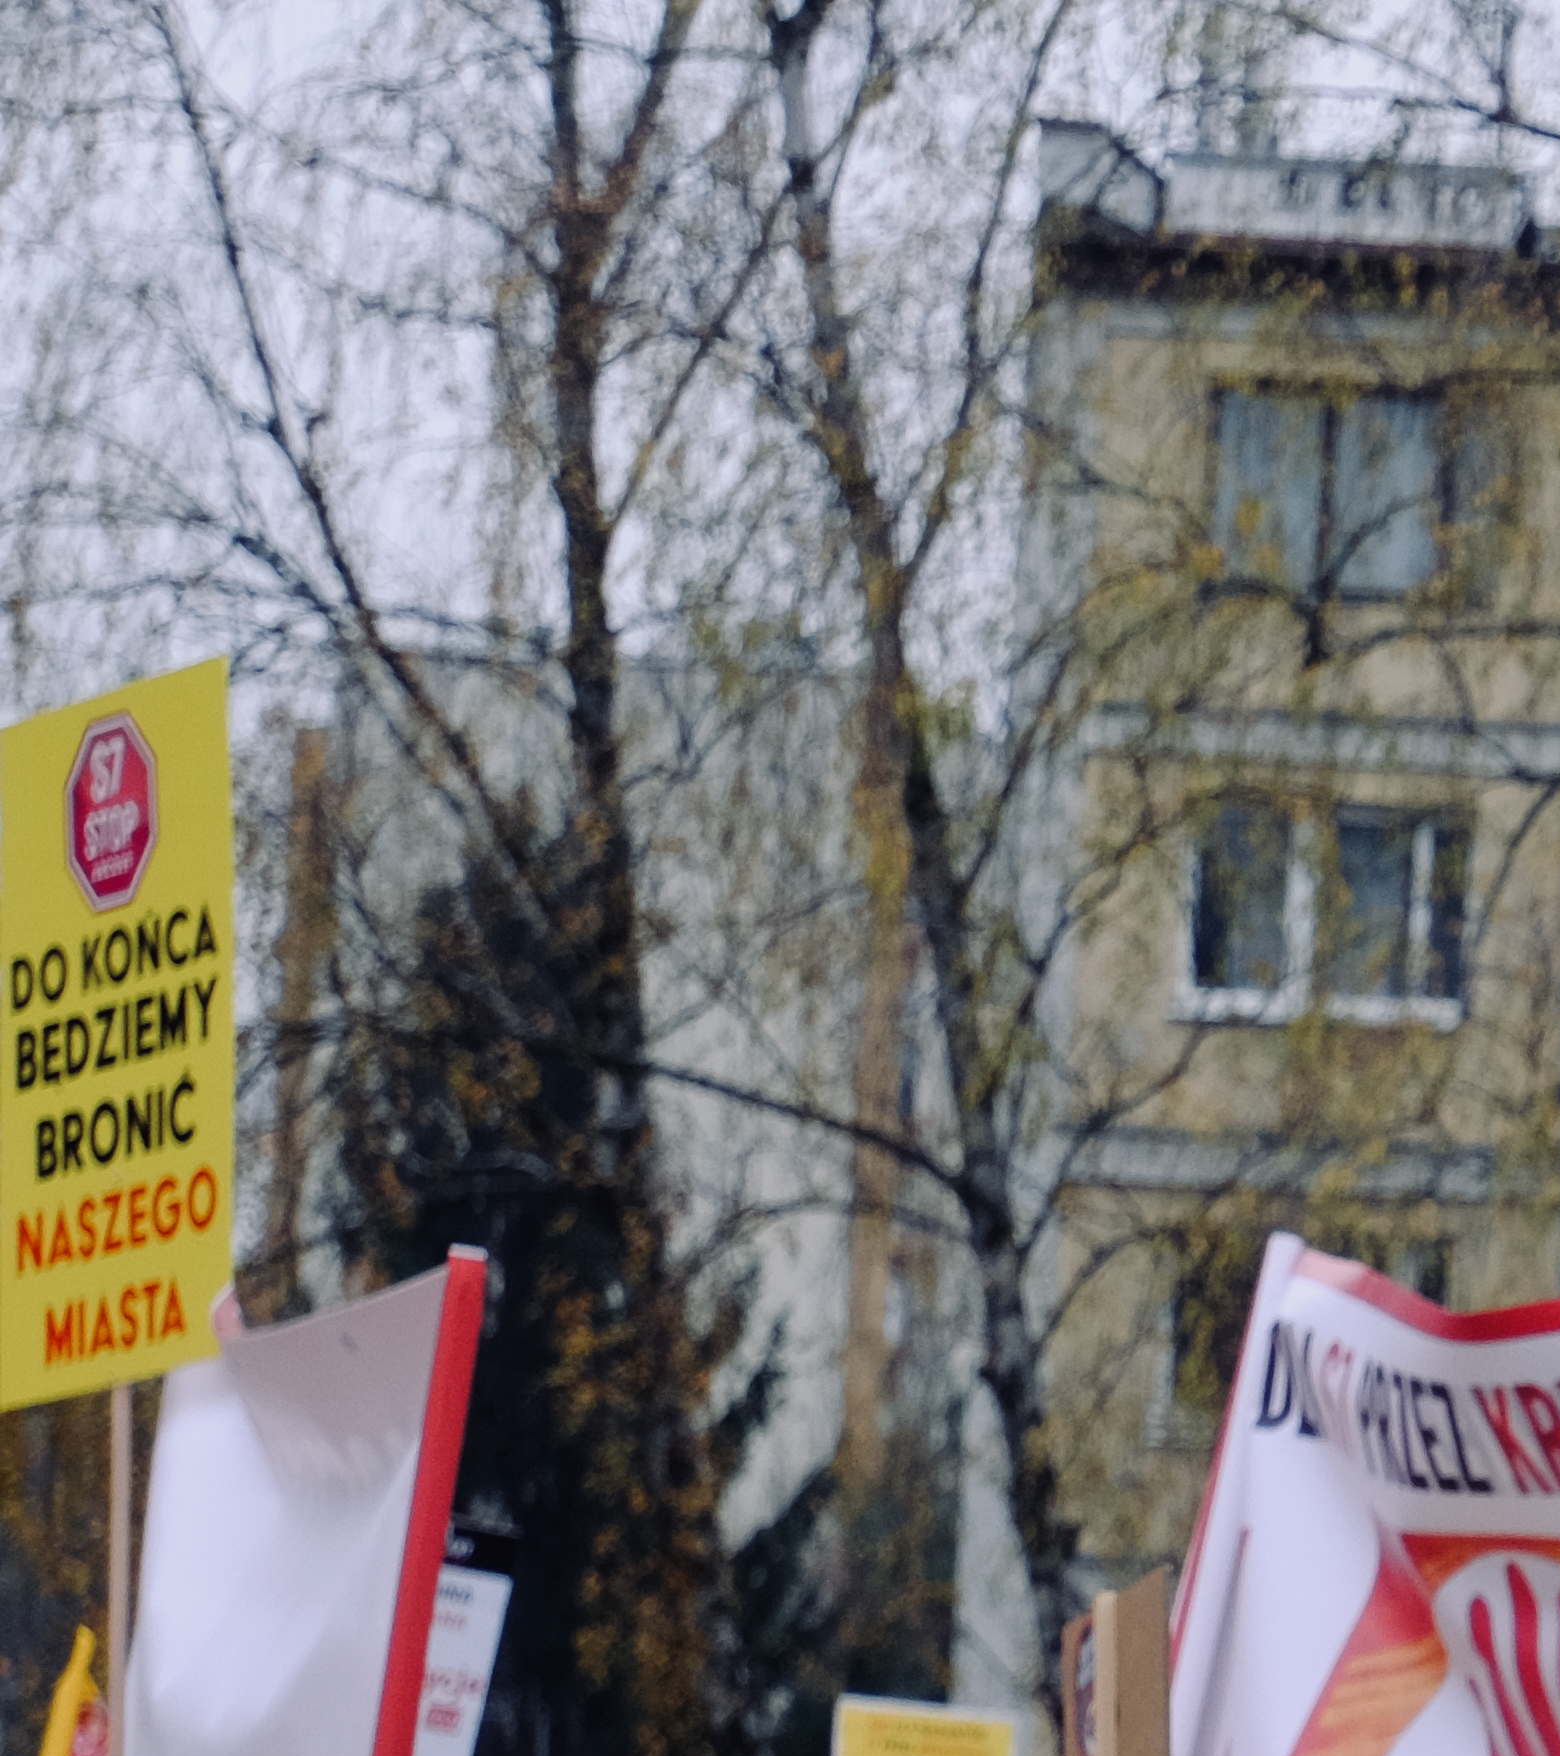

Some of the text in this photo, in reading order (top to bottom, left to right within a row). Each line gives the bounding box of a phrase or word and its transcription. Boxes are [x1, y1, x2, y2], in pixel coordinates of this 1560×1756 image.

[11, 904, 218, 1010] DO KOŃCA
[35, 1070, 197, 1180] BRONIĆ
[17, 1166, 218, 1274] NASZEGO
[44, 1276, 187, 1368] MIASTA
